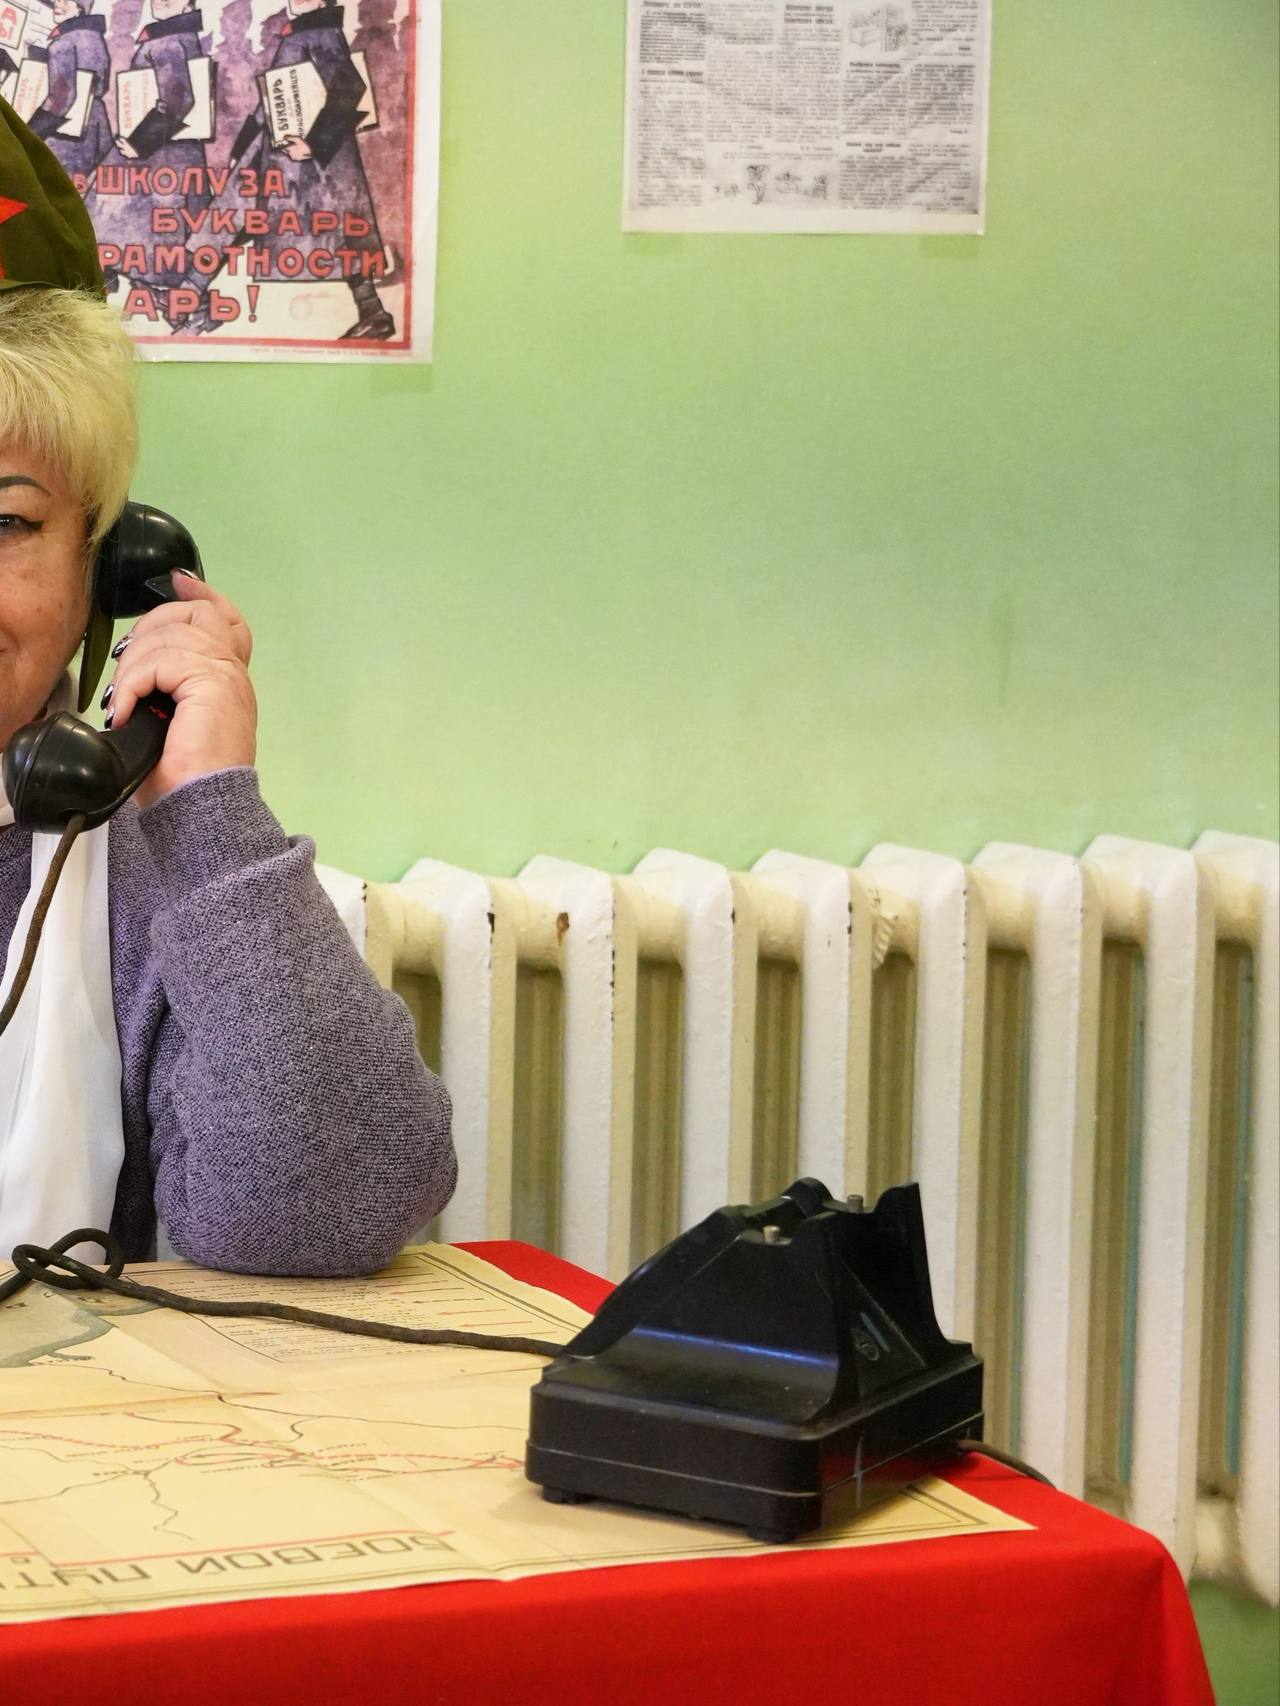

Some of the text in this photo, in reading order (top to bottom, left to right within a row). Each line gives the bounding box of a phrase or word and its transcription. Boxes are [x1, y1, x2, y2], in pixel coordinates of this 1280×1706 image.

[272, 78, 290, 132] БУКВАРЬ
[151, 207, 372, 238] БУКВАРЬ
[96, 243, 388, 279] РАМОТНОСТИ
[122, 284, 261, 323] АРЬ!
[174, 1534, 458, 1576] БОЕВОЙ
